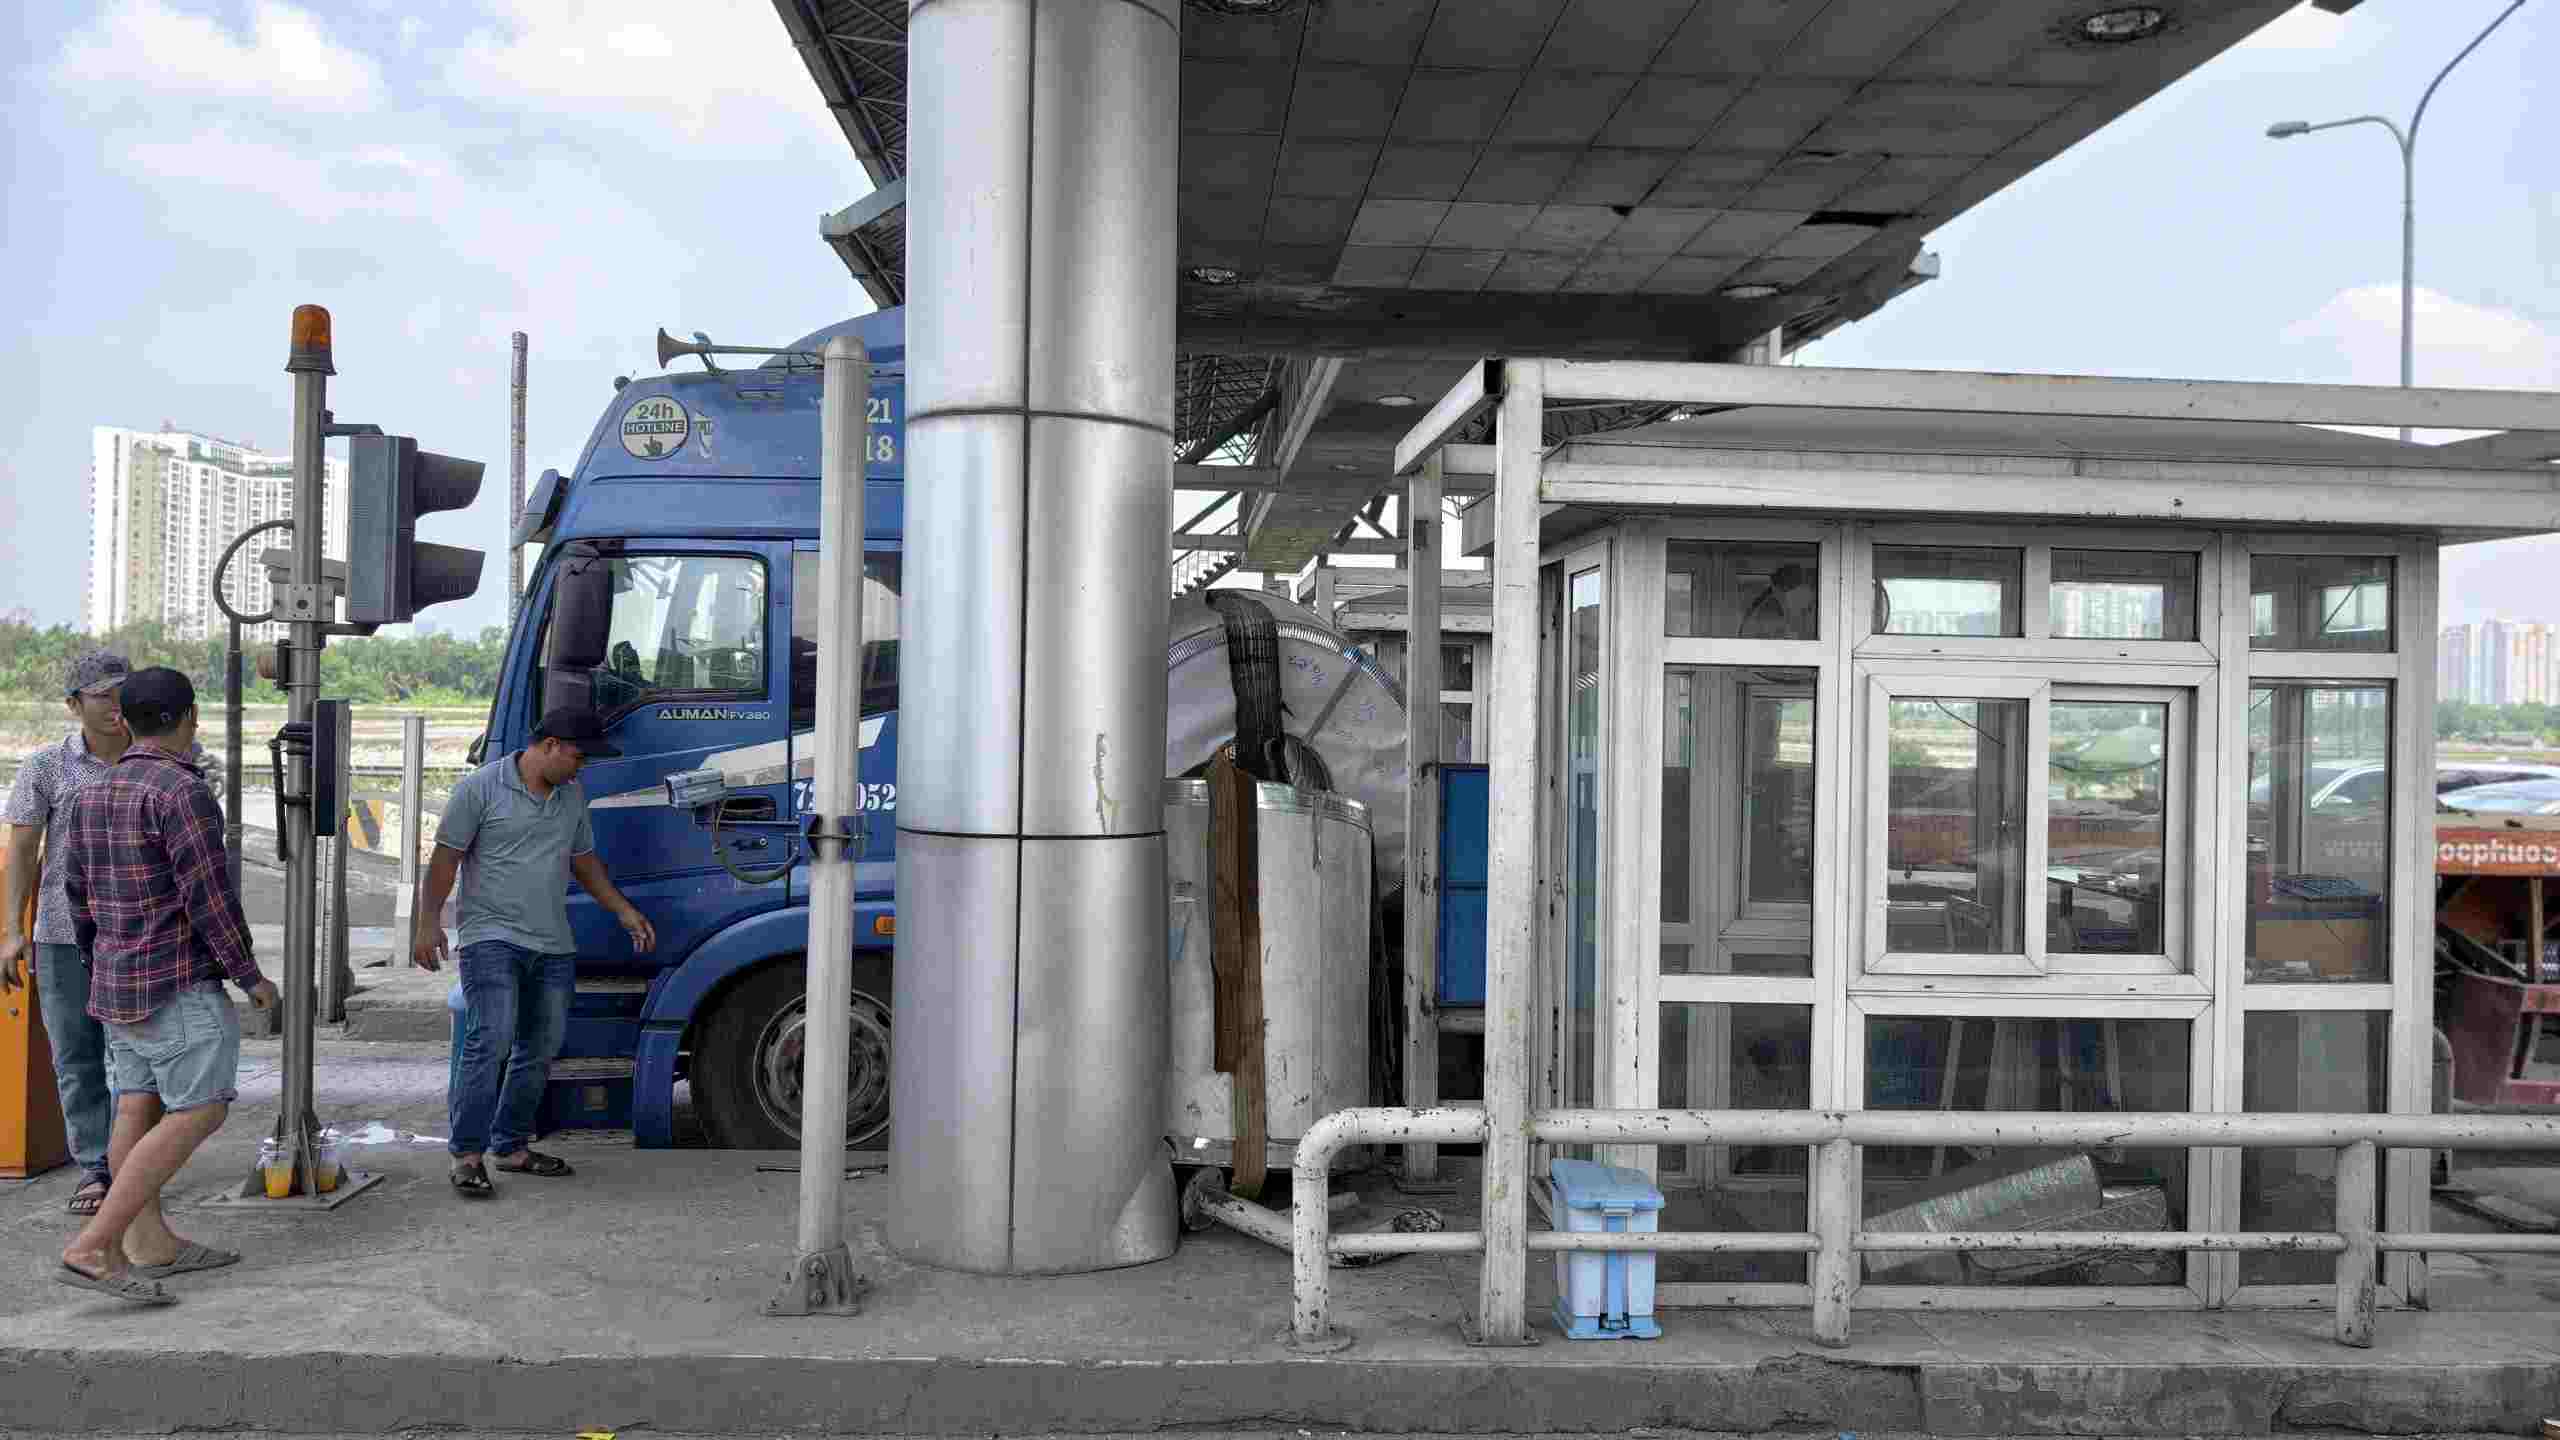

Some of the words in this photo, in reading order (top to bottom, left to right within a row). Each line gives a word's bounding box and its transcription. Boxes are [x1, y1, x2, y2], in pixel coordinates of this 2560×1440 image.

[636, 403, 672, 419] 24h
[625, 421, 685, 433] HOTLINE
[659, 708, 728, 720] AUMAN
